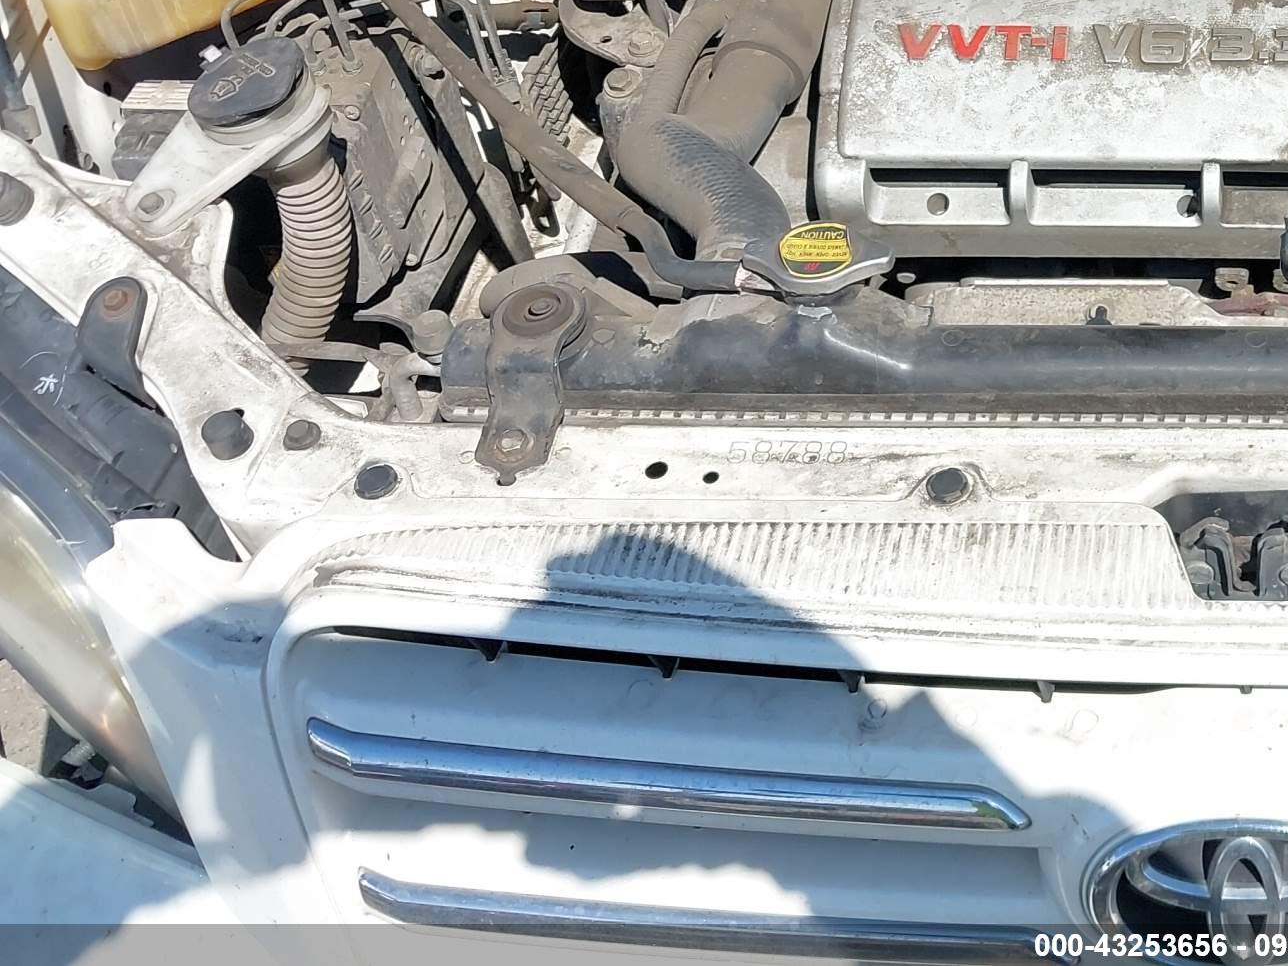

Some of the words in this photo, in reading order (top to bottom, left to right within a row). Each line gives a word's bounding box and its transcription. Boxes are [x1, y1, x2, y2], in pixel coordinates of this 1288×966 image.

[1093, 23, 1186, 64] V6
[801, 231, 844, 239] CAUTION
[727, 440, 848, 465] 58788
